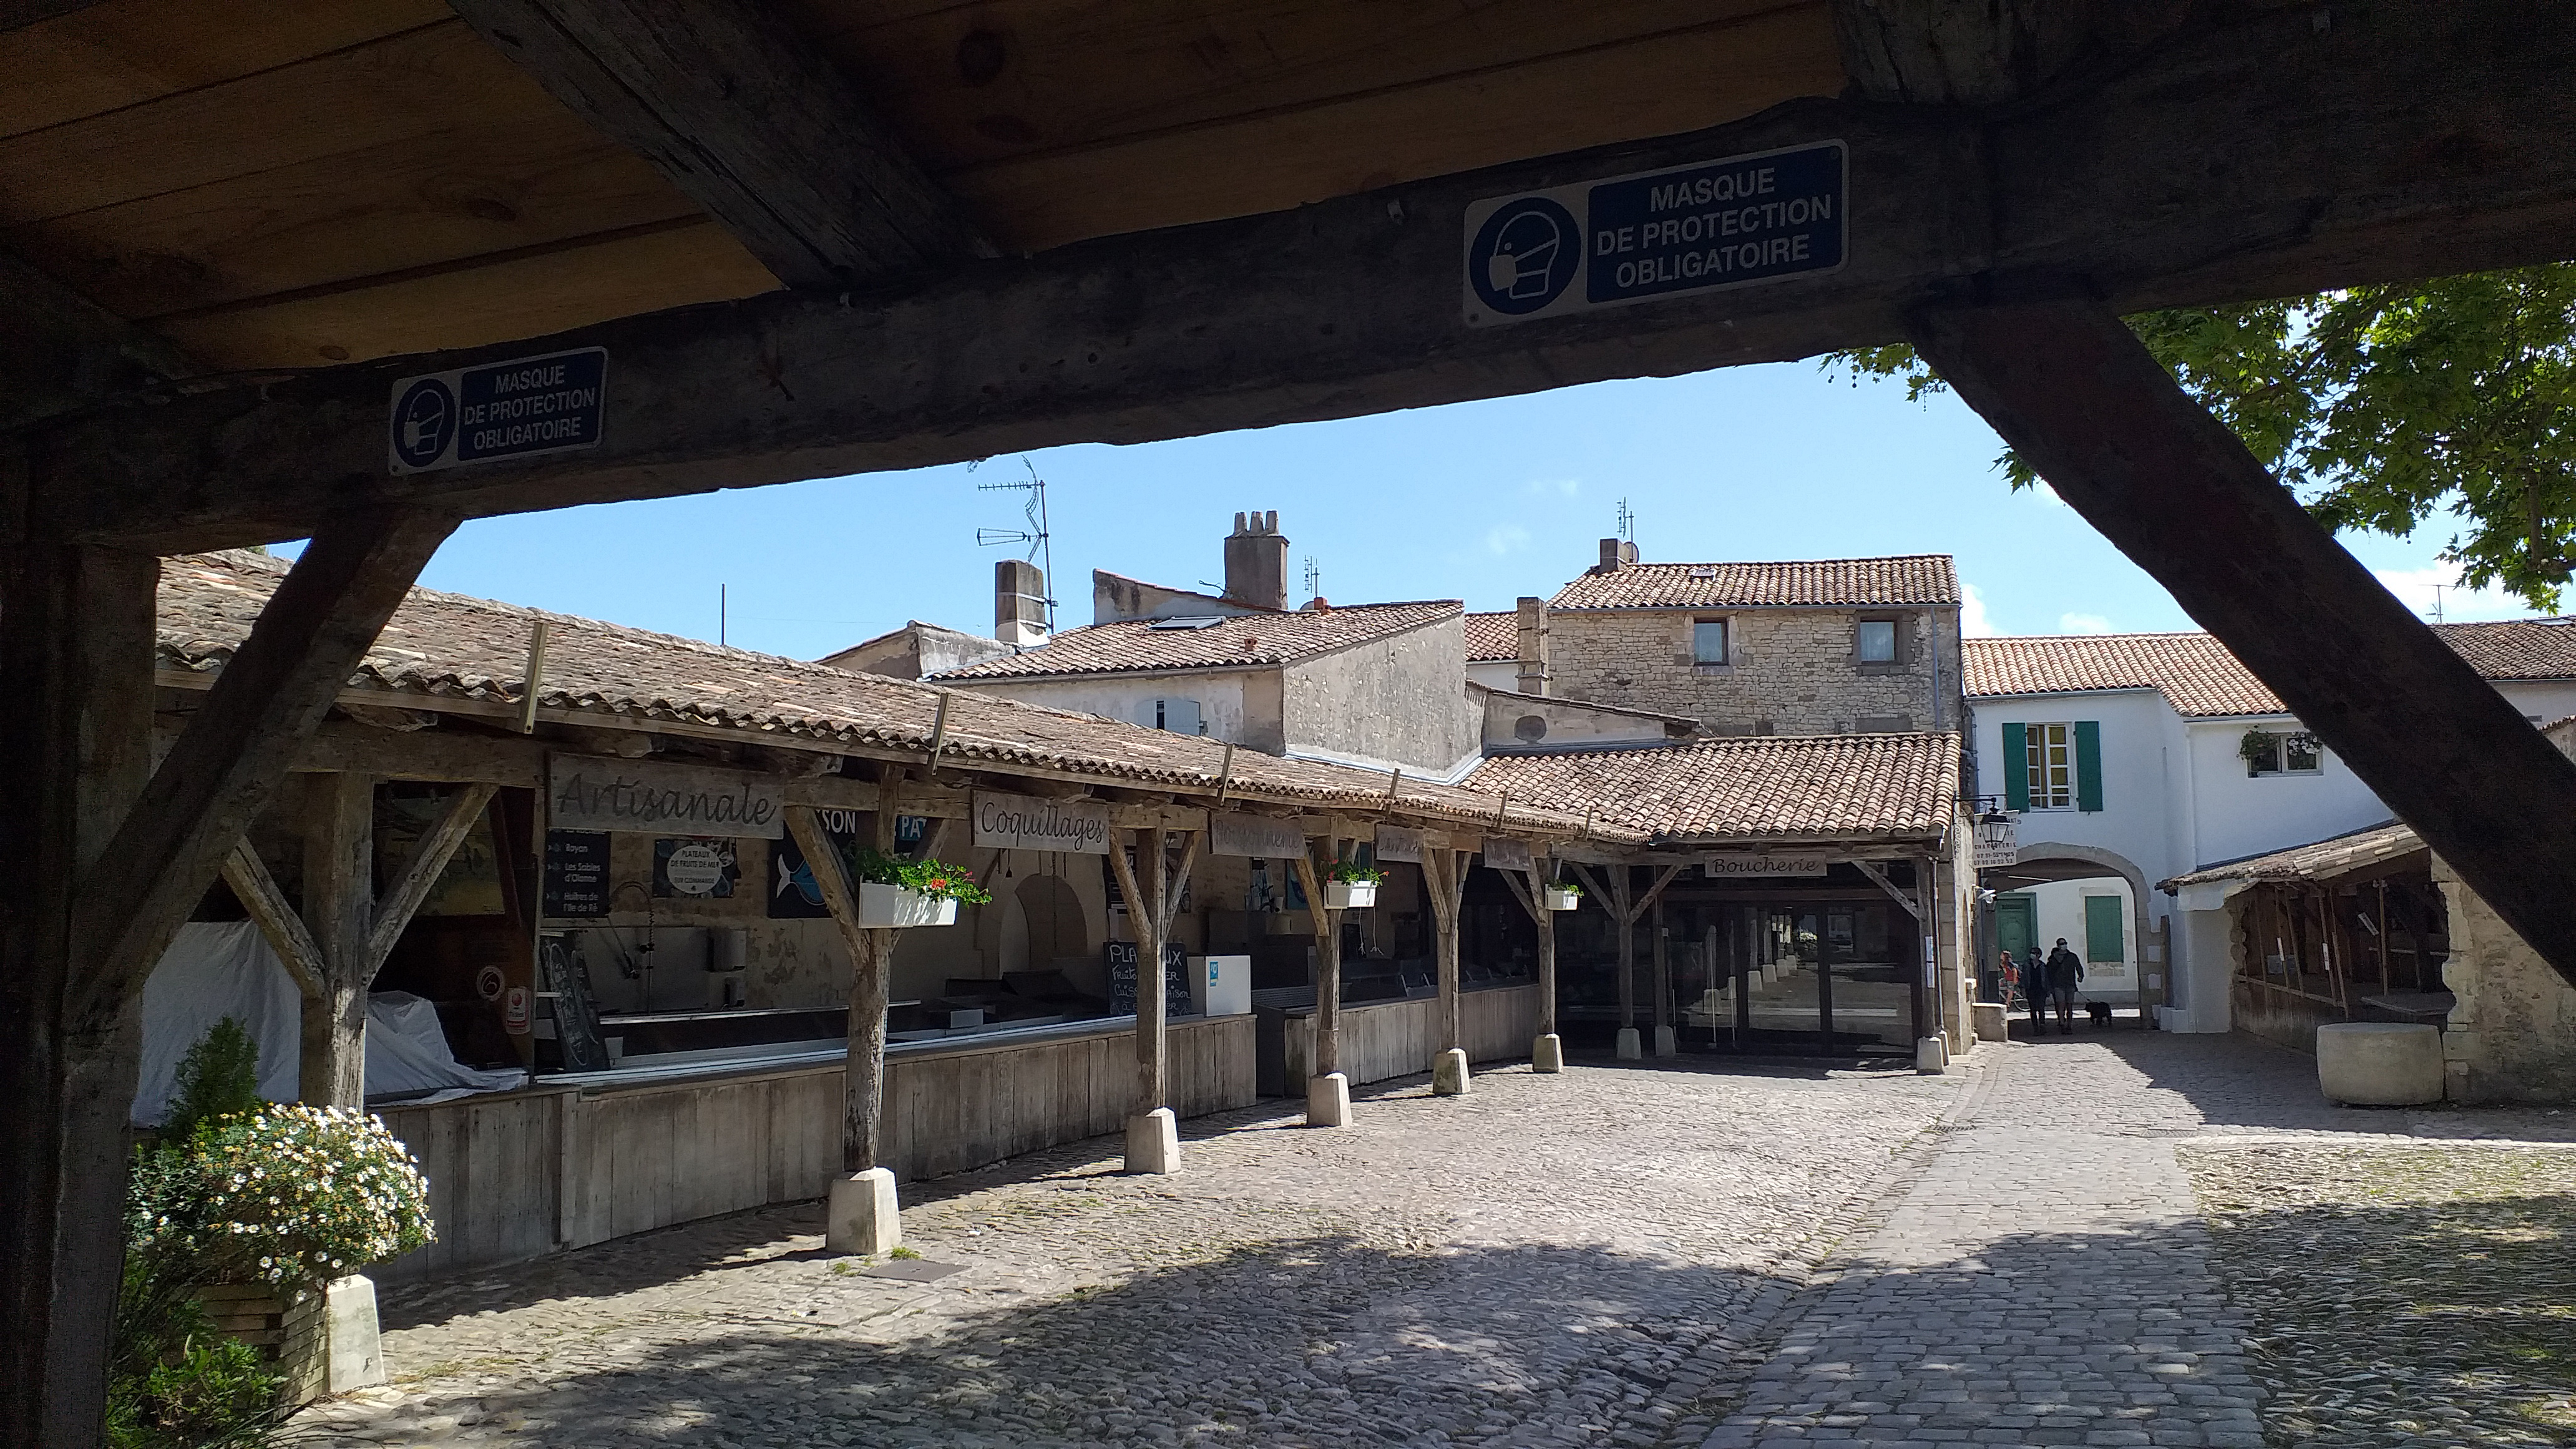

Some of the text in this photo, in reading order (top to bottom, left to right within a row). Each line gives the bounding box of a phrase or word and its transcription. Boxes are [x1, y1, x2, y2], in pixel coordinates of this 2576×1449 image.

[1650, 167, 1775, 212] MASQUE
[1596, 193, 1832, 256] DE PROTECTION
[1616, 234, 1810, 288] OBLIGATOIRE
[495, 365, 565, 394] MASQUE
[465, 388, 596, 425] DE PROTECTION
[474, 416, 582, 450] OBLIGATOIRE
[557, 772, 777, 825] Artisanale
[982, 797, 1106, 851] Coquillages
[681, 850, 711, 858] PLATEAUX
[1712, 856, 1820, 873] Boucherie
